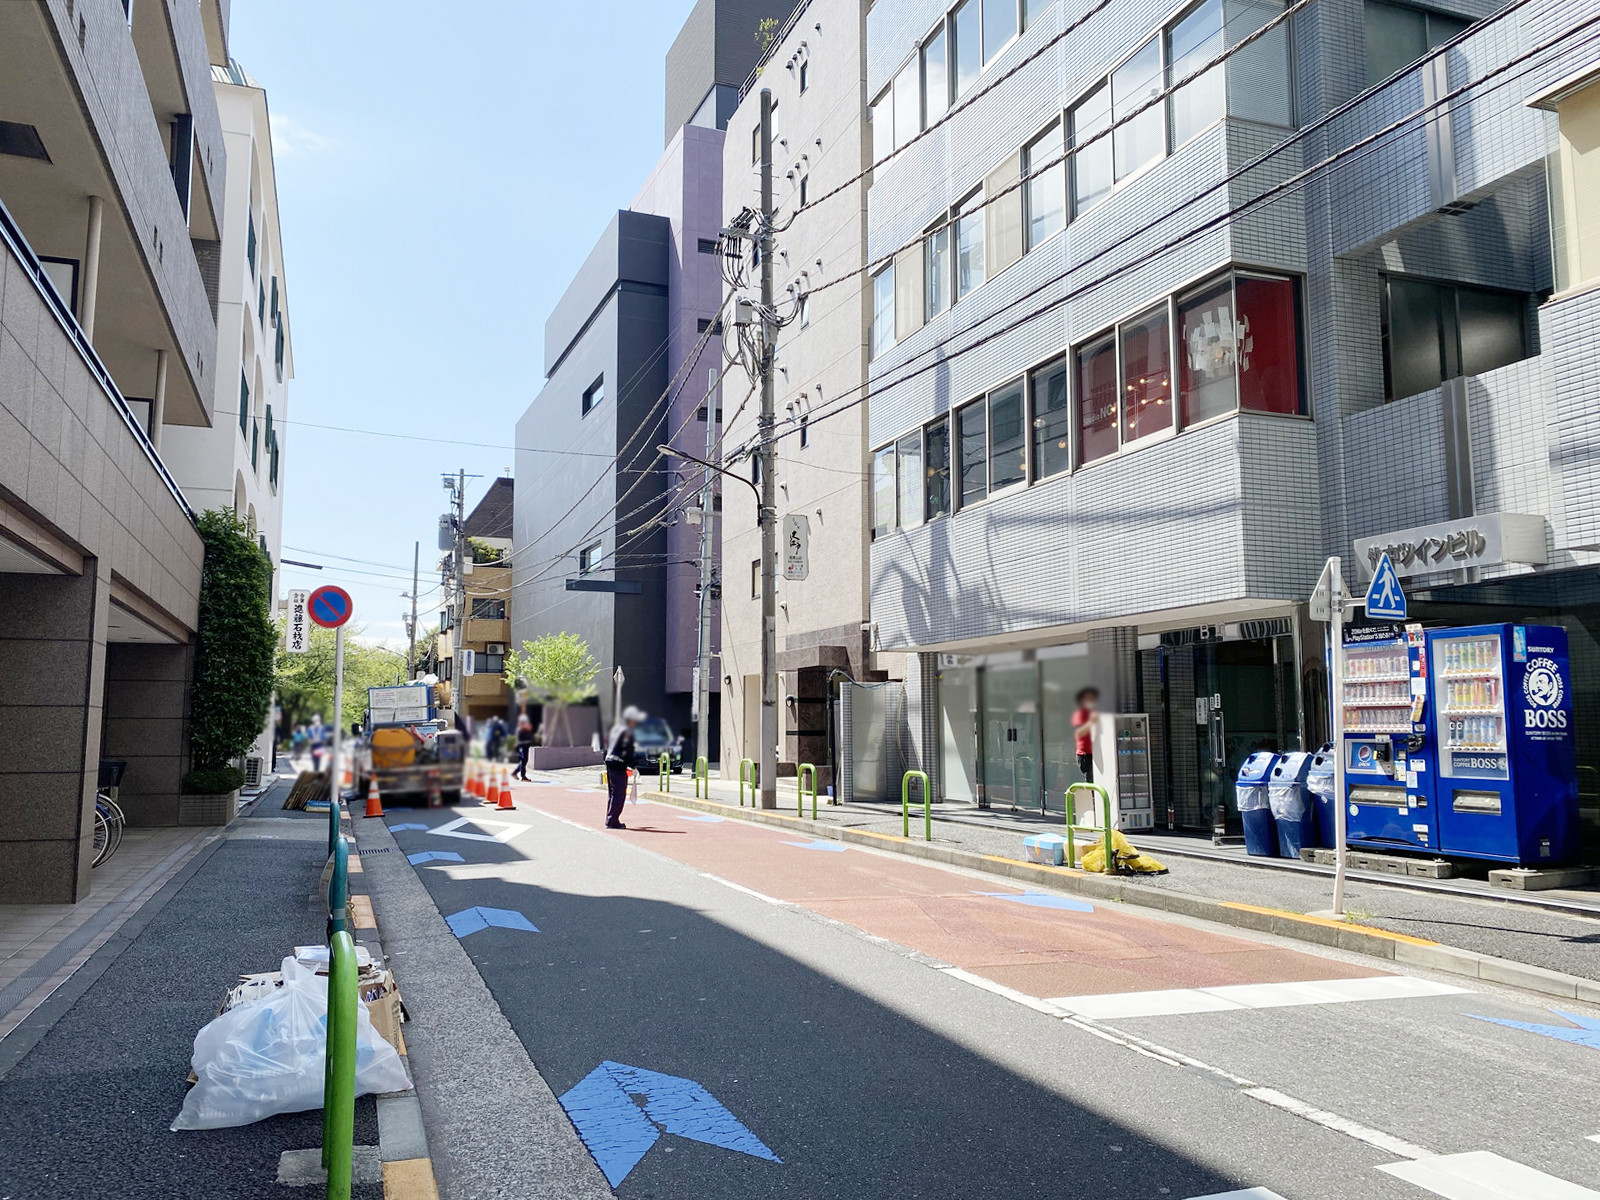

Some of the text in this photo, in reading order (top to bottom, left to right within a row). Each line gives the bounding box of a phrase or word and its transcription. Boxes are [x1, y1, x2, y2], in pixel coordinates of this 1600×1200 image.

[1526, 657, 1558, 673] COFFEE
[1524, 709, 1567, 728] BOSS
[1471, 758, 1497, 769] BOSS
